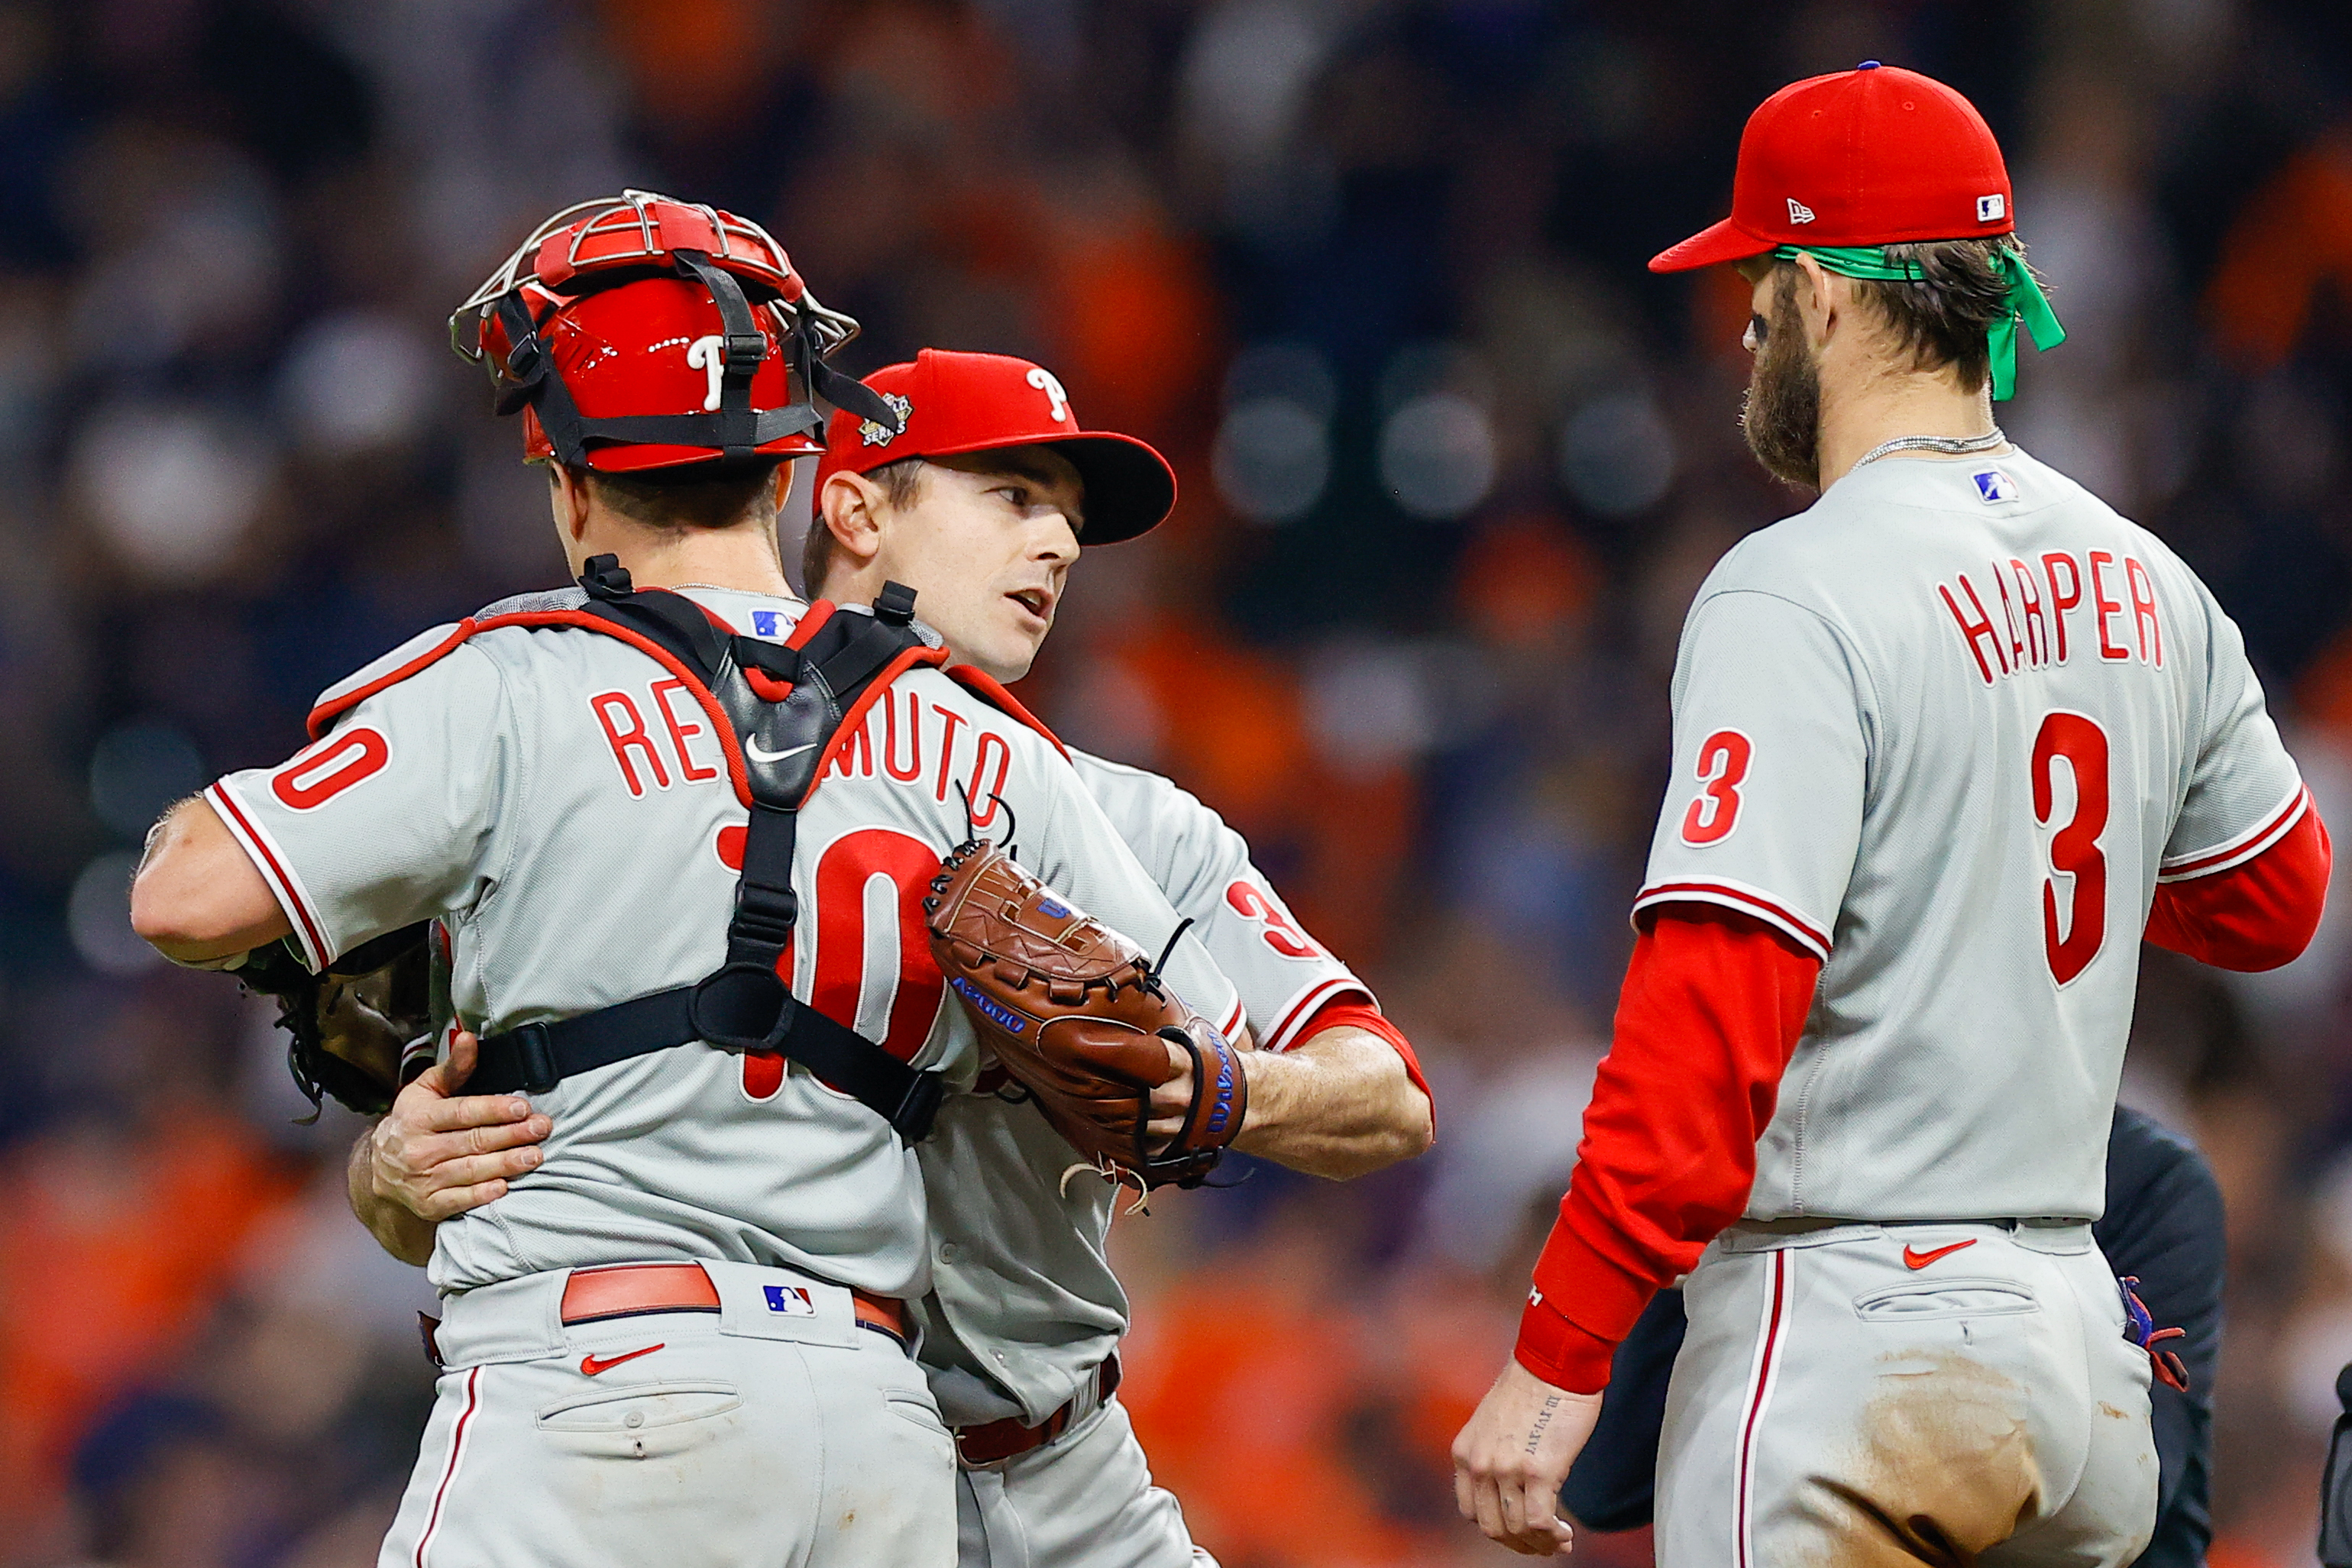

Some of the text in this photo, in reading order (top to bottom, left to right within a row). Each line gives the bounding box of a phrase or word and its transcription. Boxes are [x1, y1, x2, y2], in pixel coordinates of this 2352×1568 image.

[687, 335, 725, 412] P
[1026, 368, 1067, 422] P
[862, 421, 907, 446] SERIS
[1936, 548, 2166, 687] HARPER
[587, 671, 1011, 831] REMUTO
[1681, 726, 1756, 849] 3
[2030, 707, 2111, 992] 3
[953, 976, 1026, 1033] A2000
[1206, 1030, 1234, 1133] Wilson
